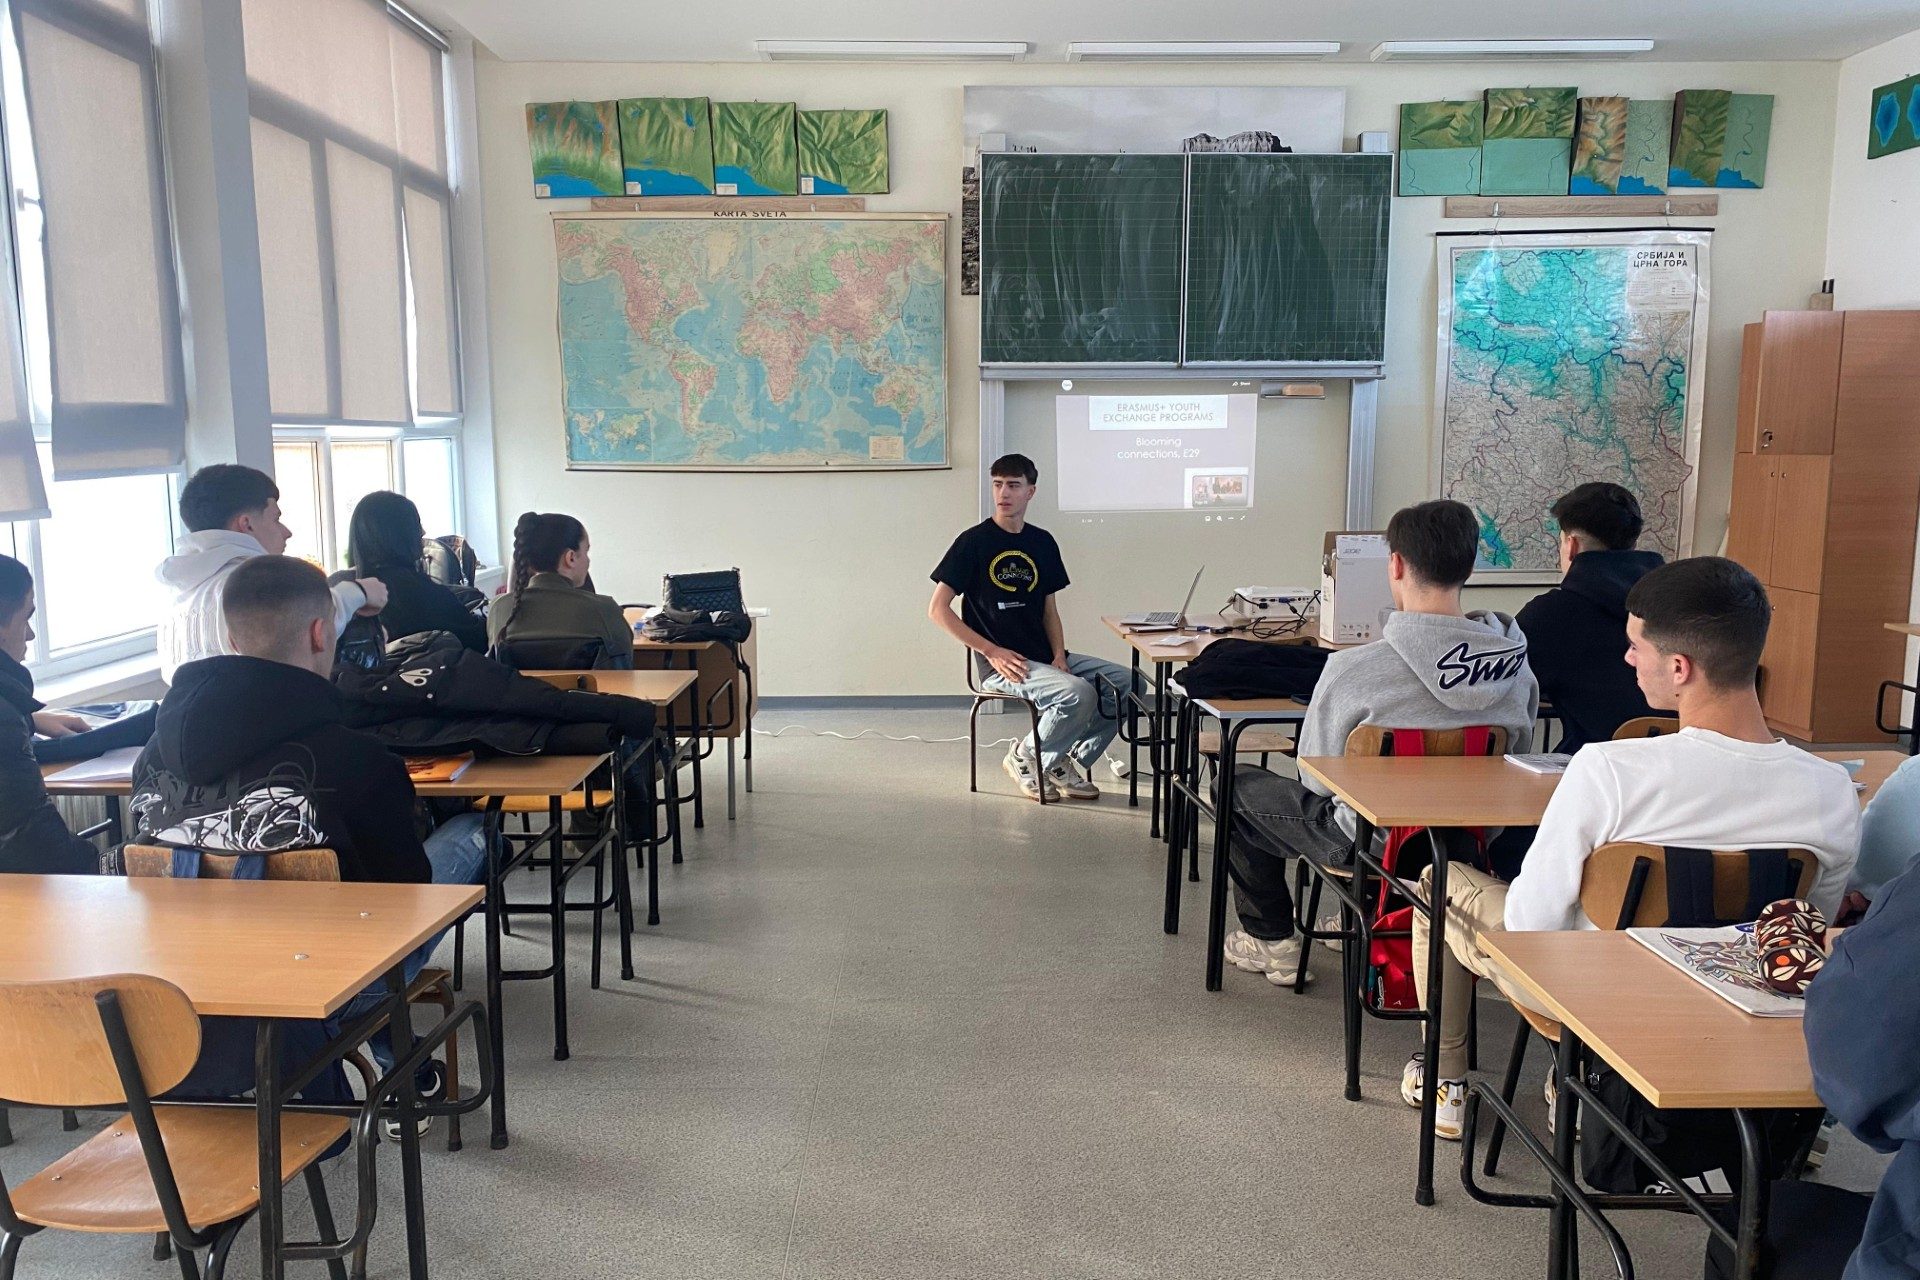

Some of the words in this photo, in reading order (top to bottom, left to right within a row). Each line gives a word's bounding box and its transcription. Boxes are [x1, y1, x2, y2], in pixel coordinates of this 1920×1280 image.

[1633, 260, 1659, 268] ЦРНА
[1117, 403, 1165, 412] ERASMUS+
[1169, 402, 1200, 411] YOUTH
[1103, 413, 1156, 422] EXCHANGE
[1159, 412, 1213, 422] PROGRAMS
[1136, 436, 1182, 447] Blooming
[1183, 448, 1200, 458] E29
